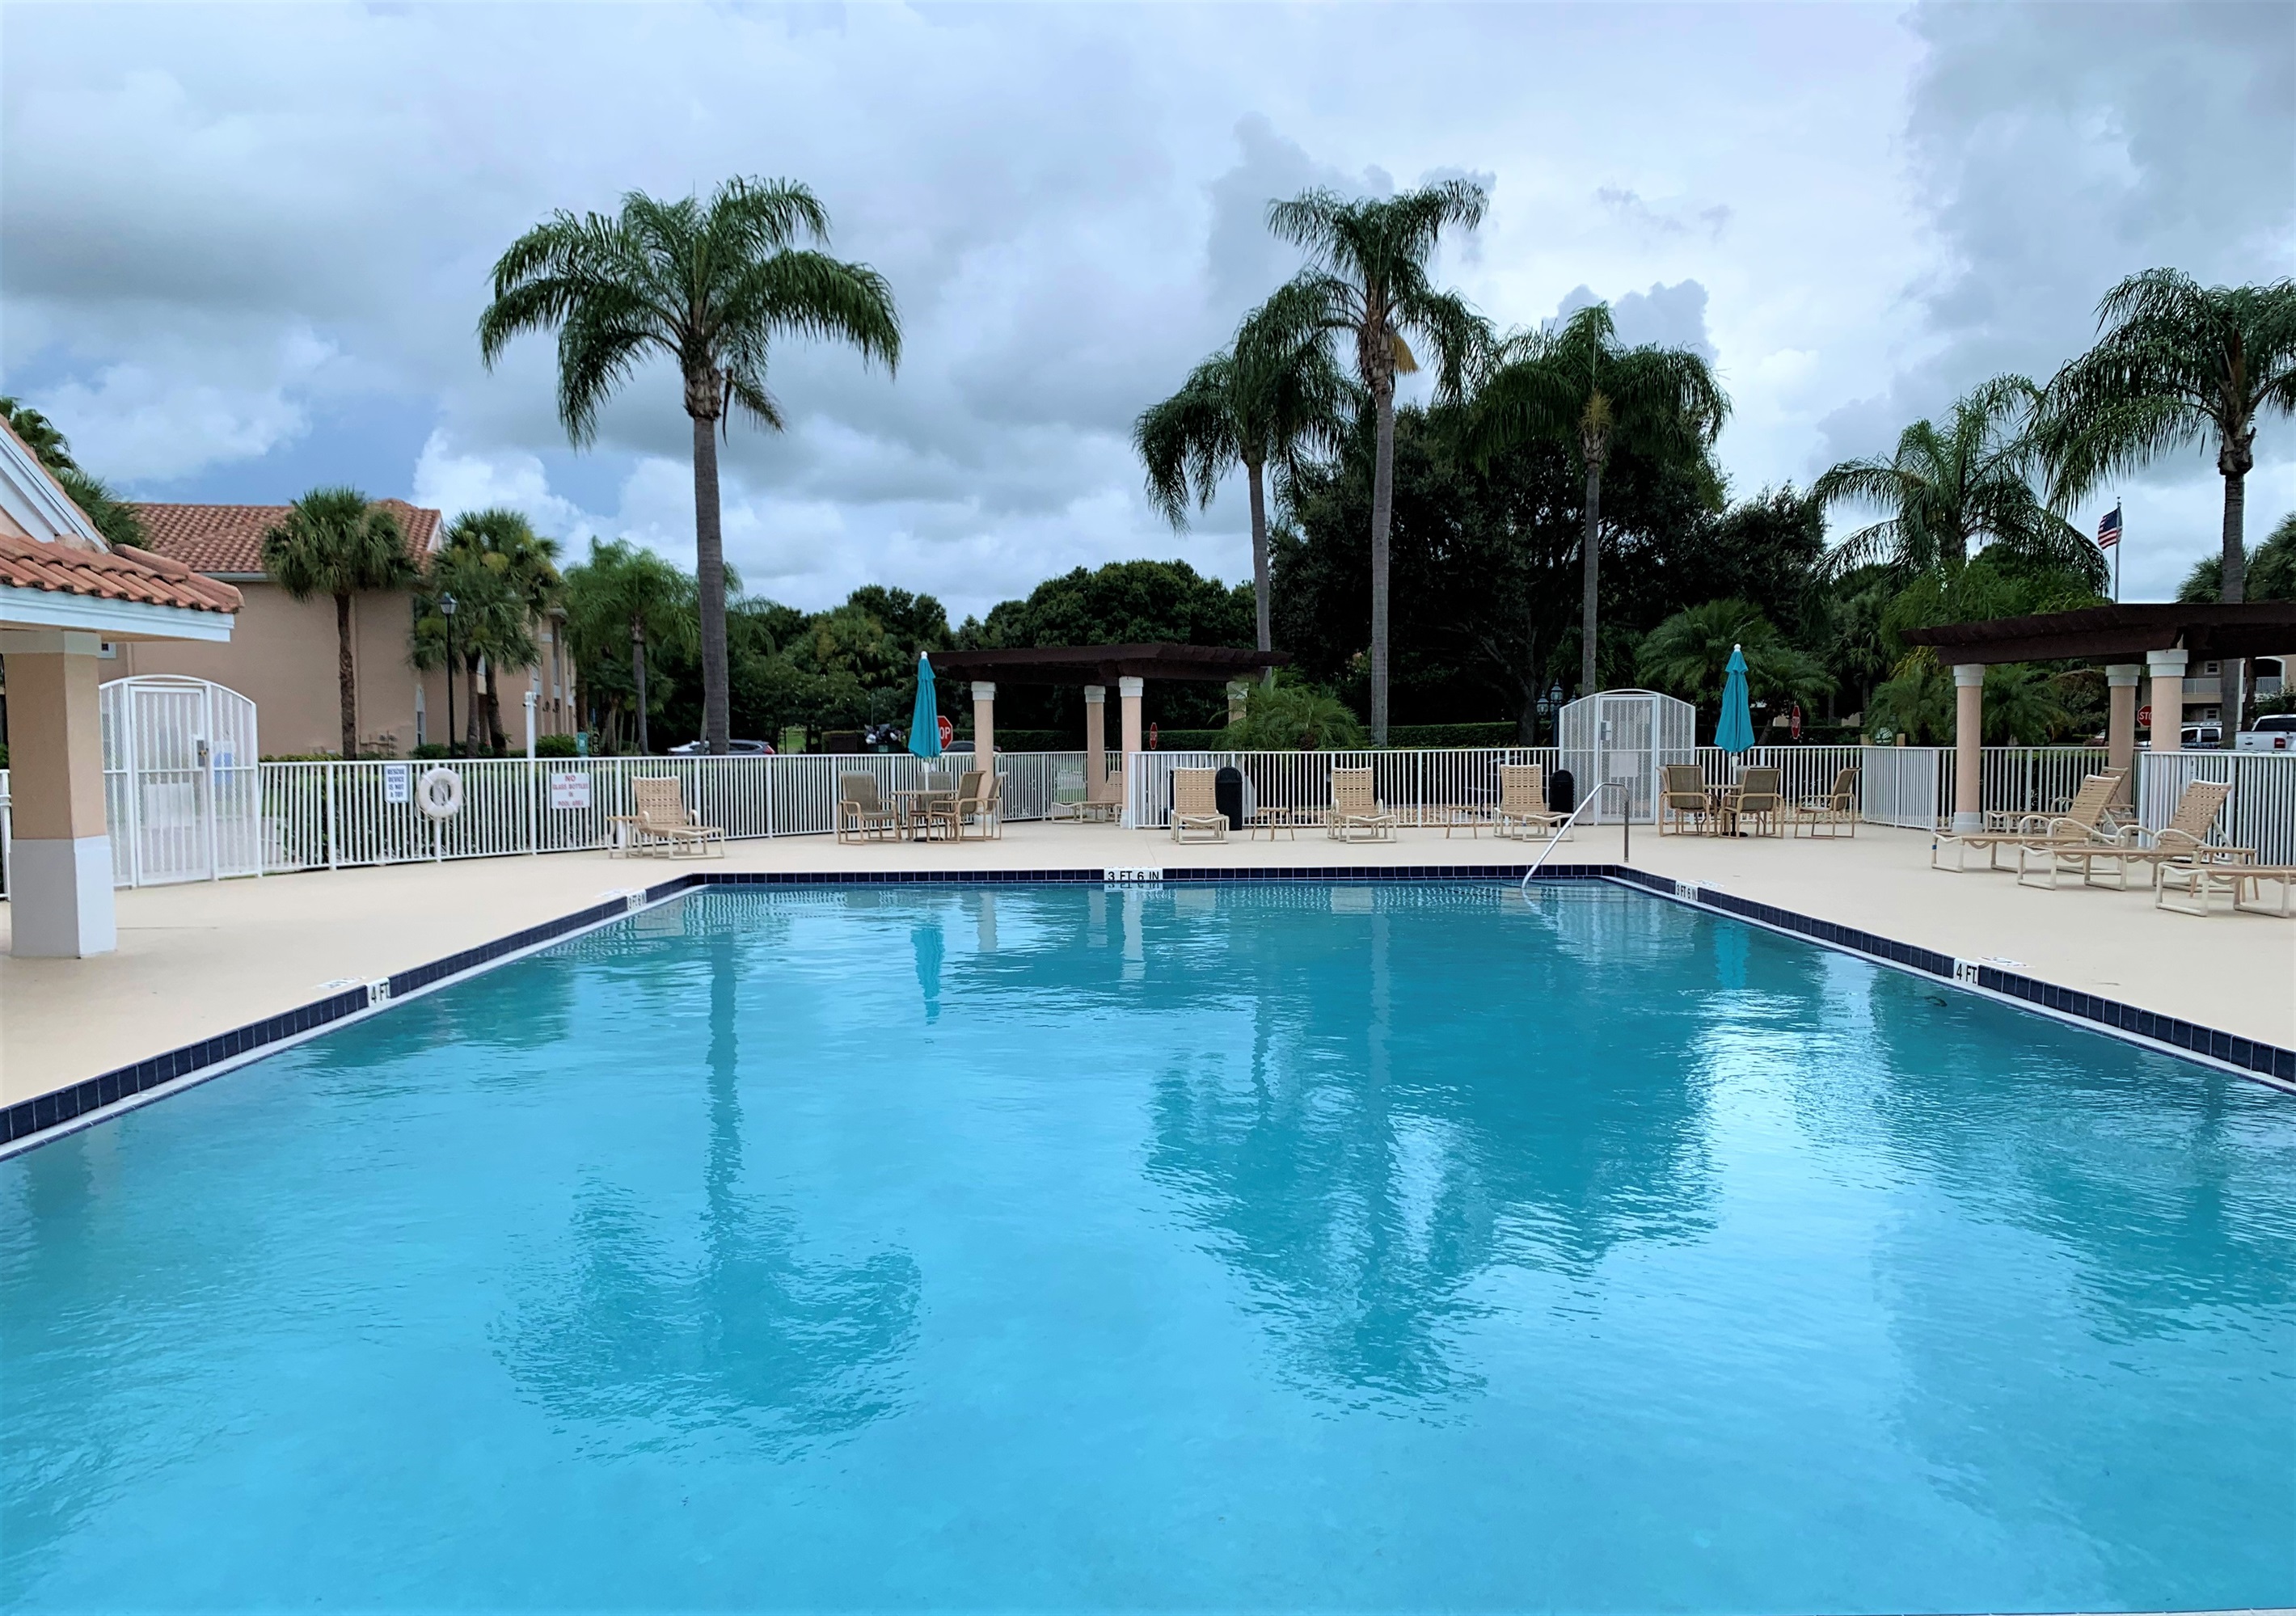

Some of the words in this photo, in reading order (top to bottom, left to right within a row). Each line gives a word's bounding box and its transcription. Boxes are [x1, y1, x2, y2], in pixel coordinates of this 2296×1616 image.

[939, 727, 951, 740] OP
[1108, 871, 1115, 880] 3
[1137, 871, 1144, 880] 6
[1677, 884, 1680, 896] 3
[1687, 888, 1691, 899] 6
[1956, 964, 1962, 980] 4
[371, 985, 377, 1003] 4
